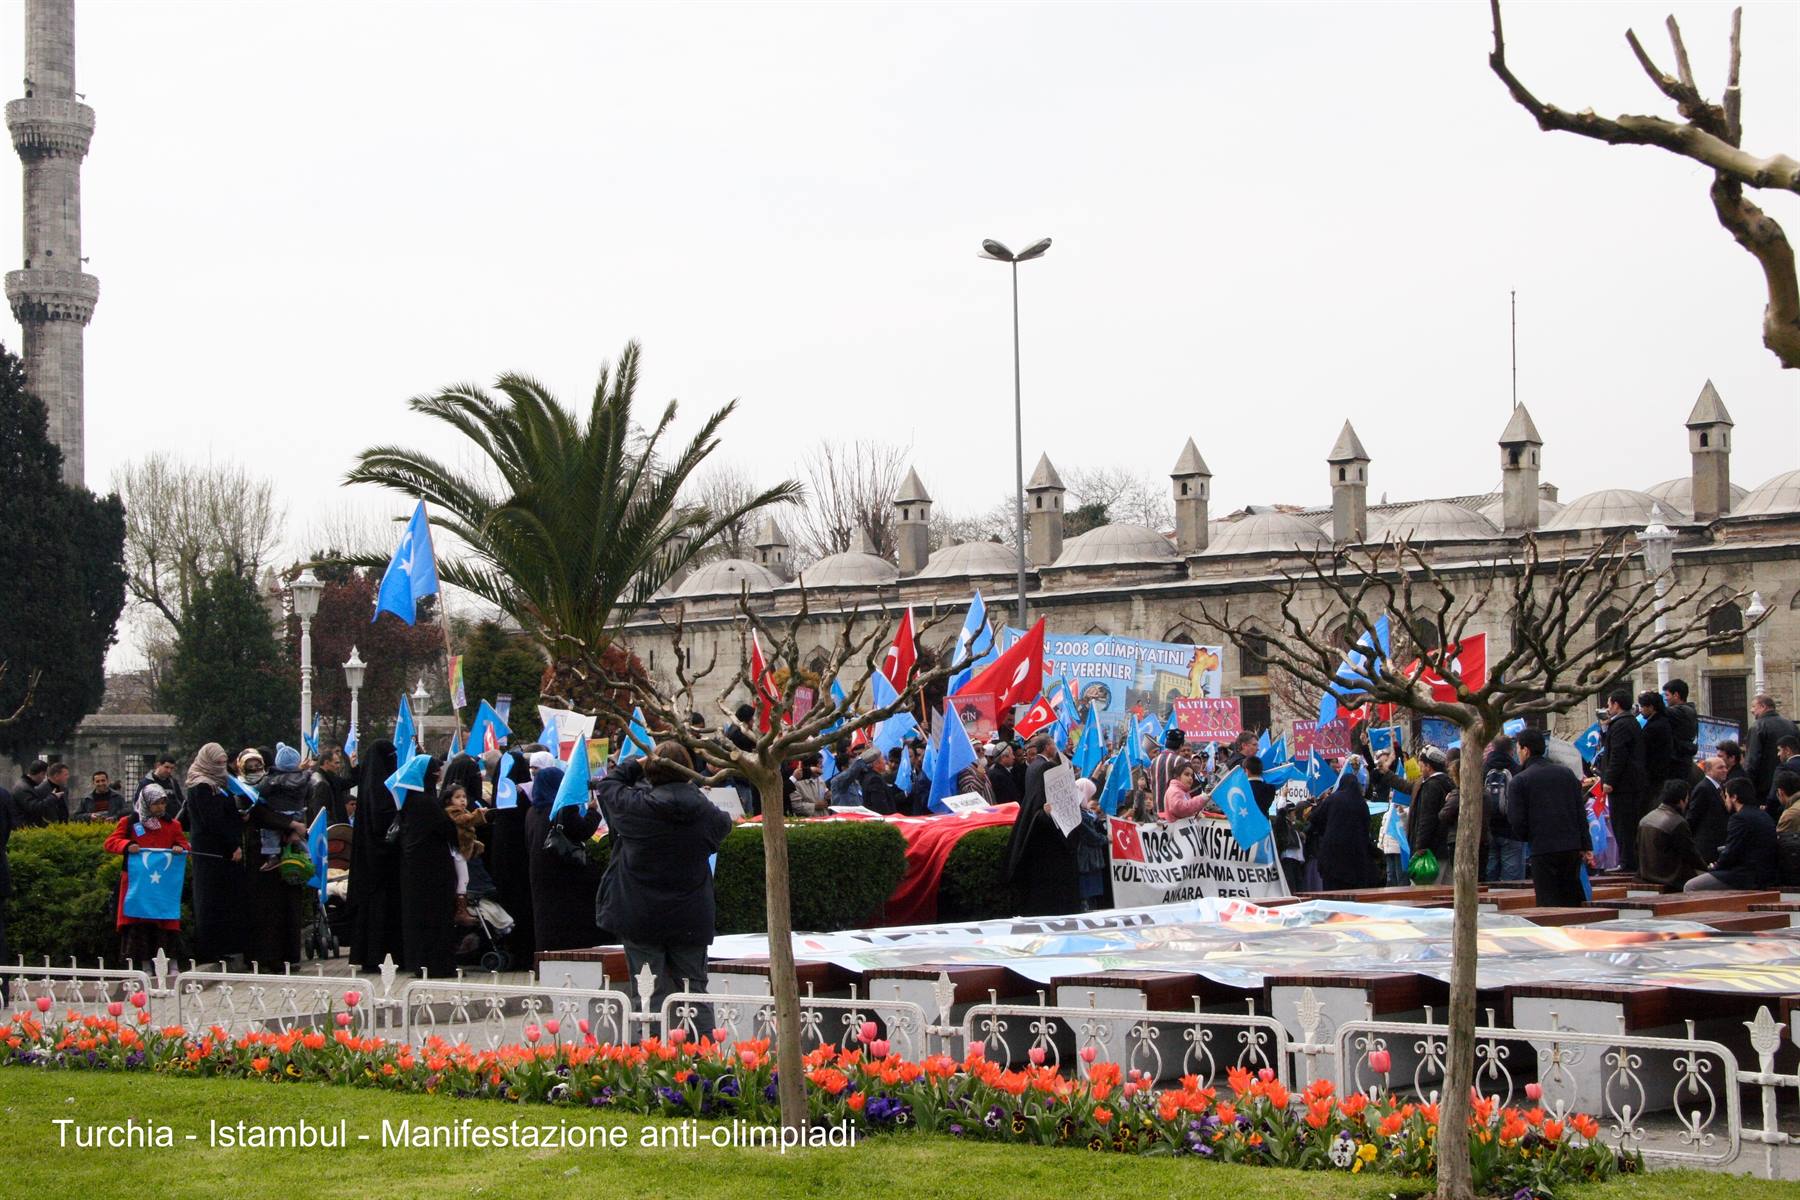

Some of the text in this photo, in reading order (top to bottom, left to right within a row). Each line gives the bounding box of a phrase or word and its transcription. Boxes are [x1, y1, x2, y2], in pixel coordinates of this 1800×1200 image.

[1055, 641, 1089, 656] 2008
[1093, 638, 1184, 665] OLİMPİYATINI
[1071, 662, 1132, 680] VERENLER
[1184, 729, 1212, 737] İLLER
[1142, 824, 1184, 864] DOĞU
[1113, 861, 1163, 884] KÜLTÜR
[1161, 866, 1182, 884] VE
[1162, 885, 1204, 904] ANKARA
